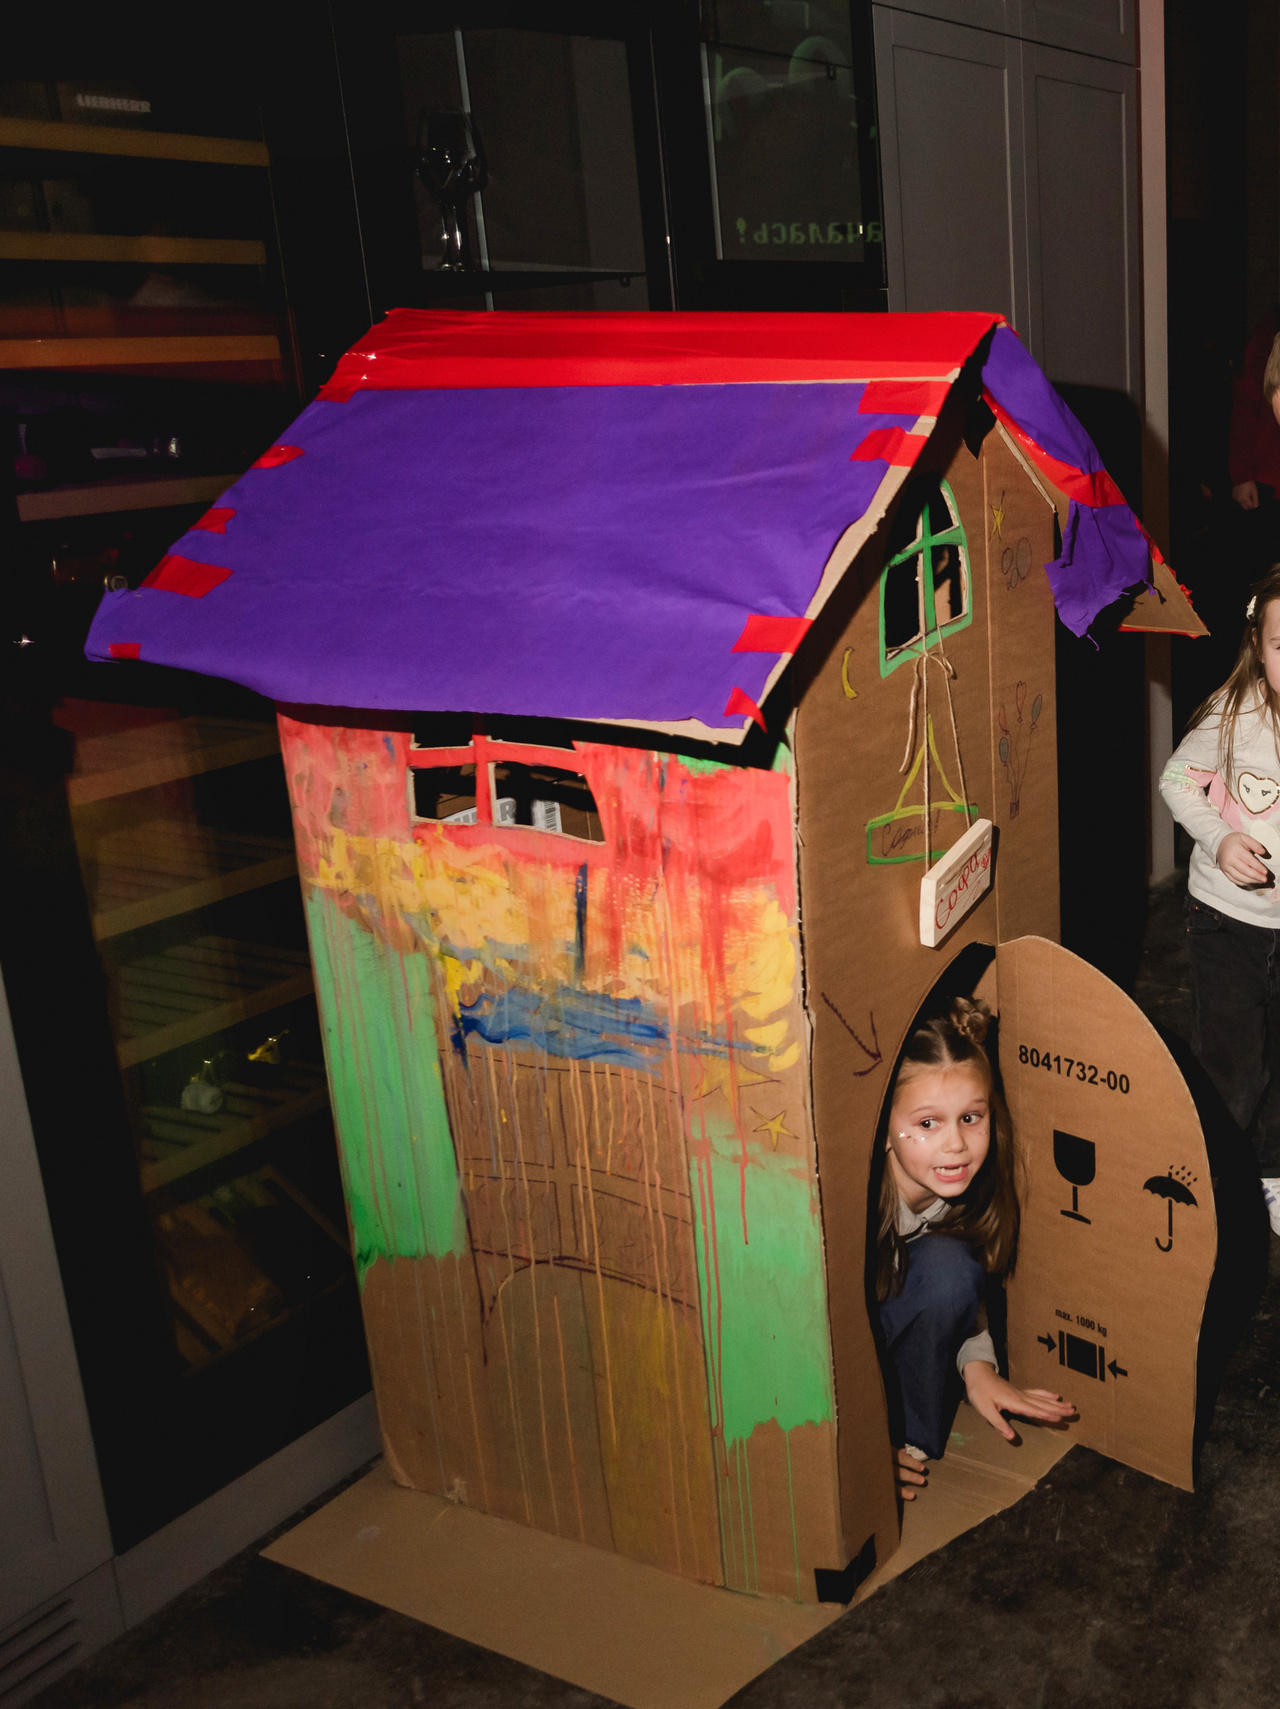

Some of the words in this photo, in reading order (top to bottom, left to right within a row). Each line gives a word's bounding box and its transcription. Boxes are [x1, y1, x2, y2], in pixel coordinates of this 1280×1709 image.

[1018, 1044, 1130, 1095] 8041732-00
[1055, 1308, 1073, 1322] max.
[1076, 1315, 1096, 1331] 1000
[1097, 1323, 1108, 1338] kg
